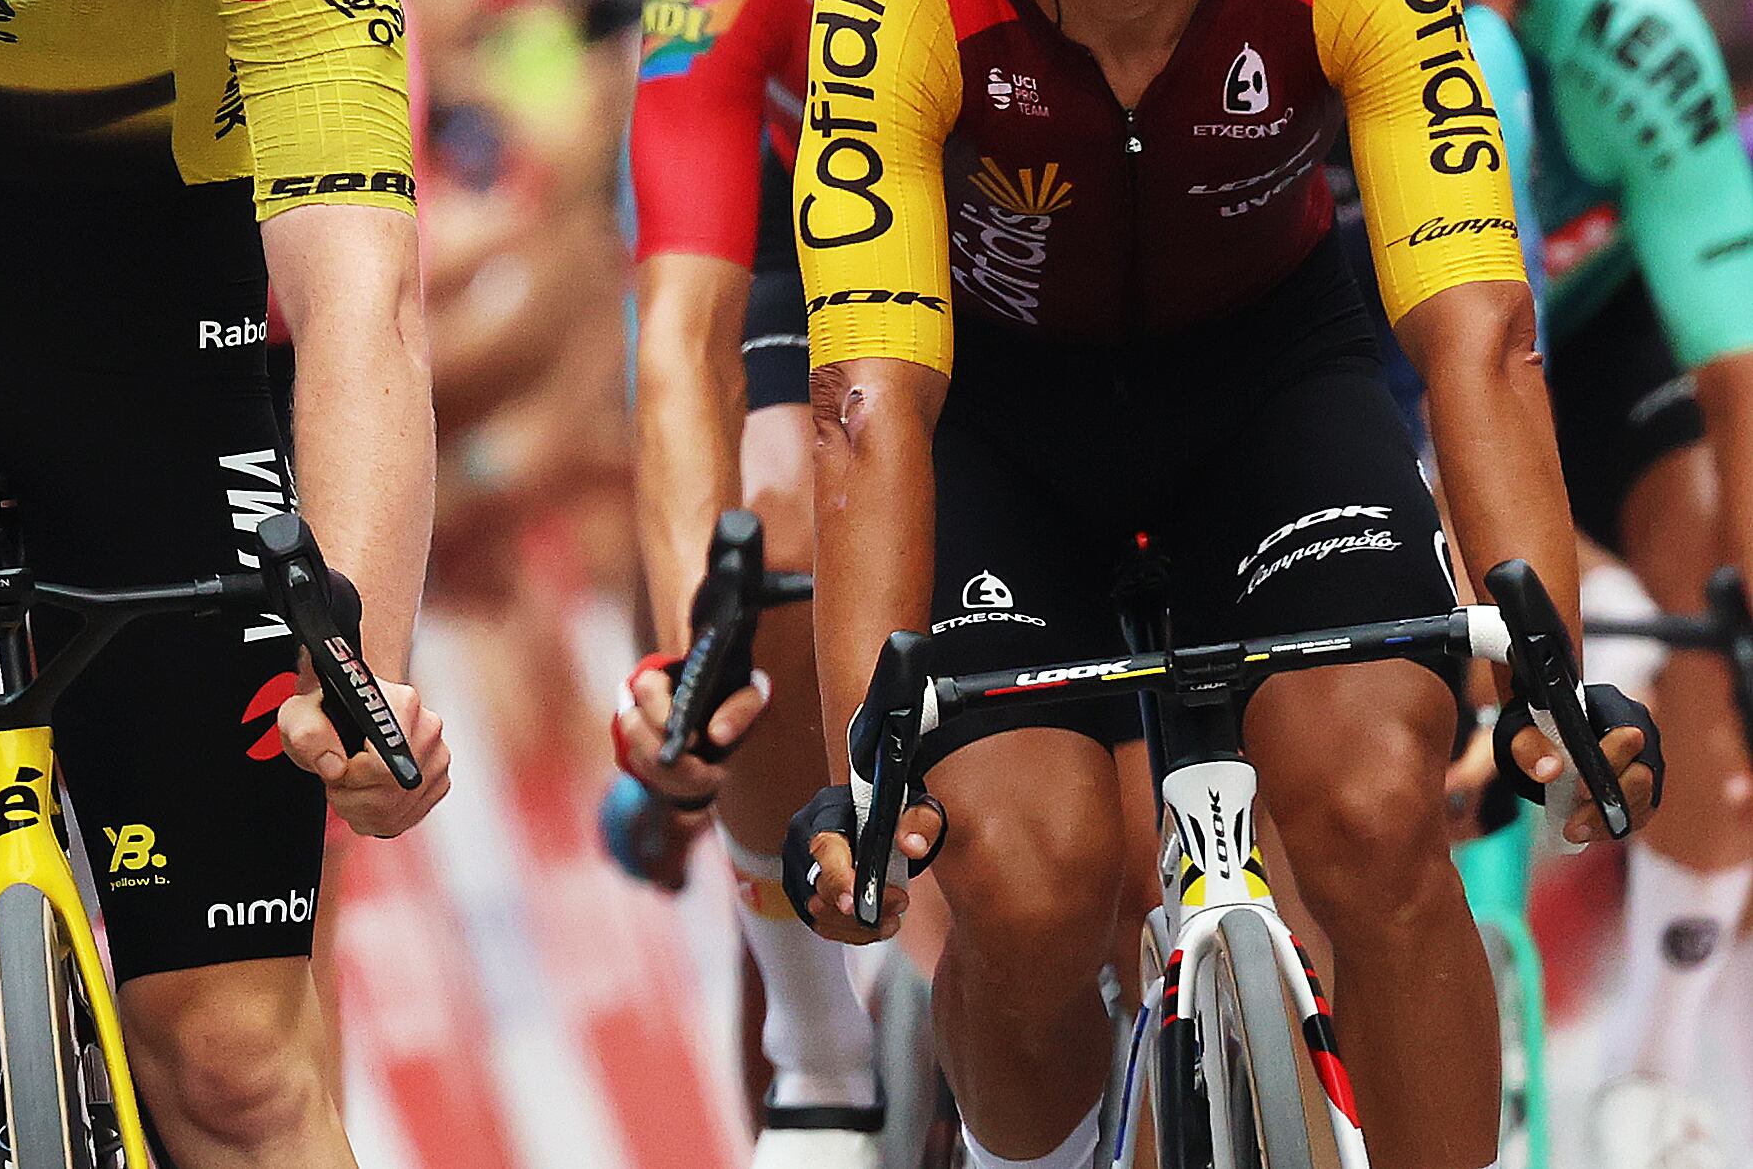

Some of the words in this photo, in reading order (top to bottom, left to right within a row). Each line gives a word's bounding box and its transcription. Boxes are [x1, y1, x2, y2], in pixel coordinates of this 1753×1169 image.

[1012, 74, 1037, 90] UCI
[1014, 88, 1039, 103] PRO
[1018, 102, 1050, 118] TEAM
[951, 203, 1052, 325] Cofidis
[1237, 504, 1392, 575] LOOK
[1236, 528, 1401, 605] Campagnolo
[323, 635, 406, 749] SRAM
[1015, 659, 1133, 687] LOOK
[1207, 786, 1231, 880] LOOK
[110, 877, 151, 891] yellow
[207, 887, 315, 929] nimbl
